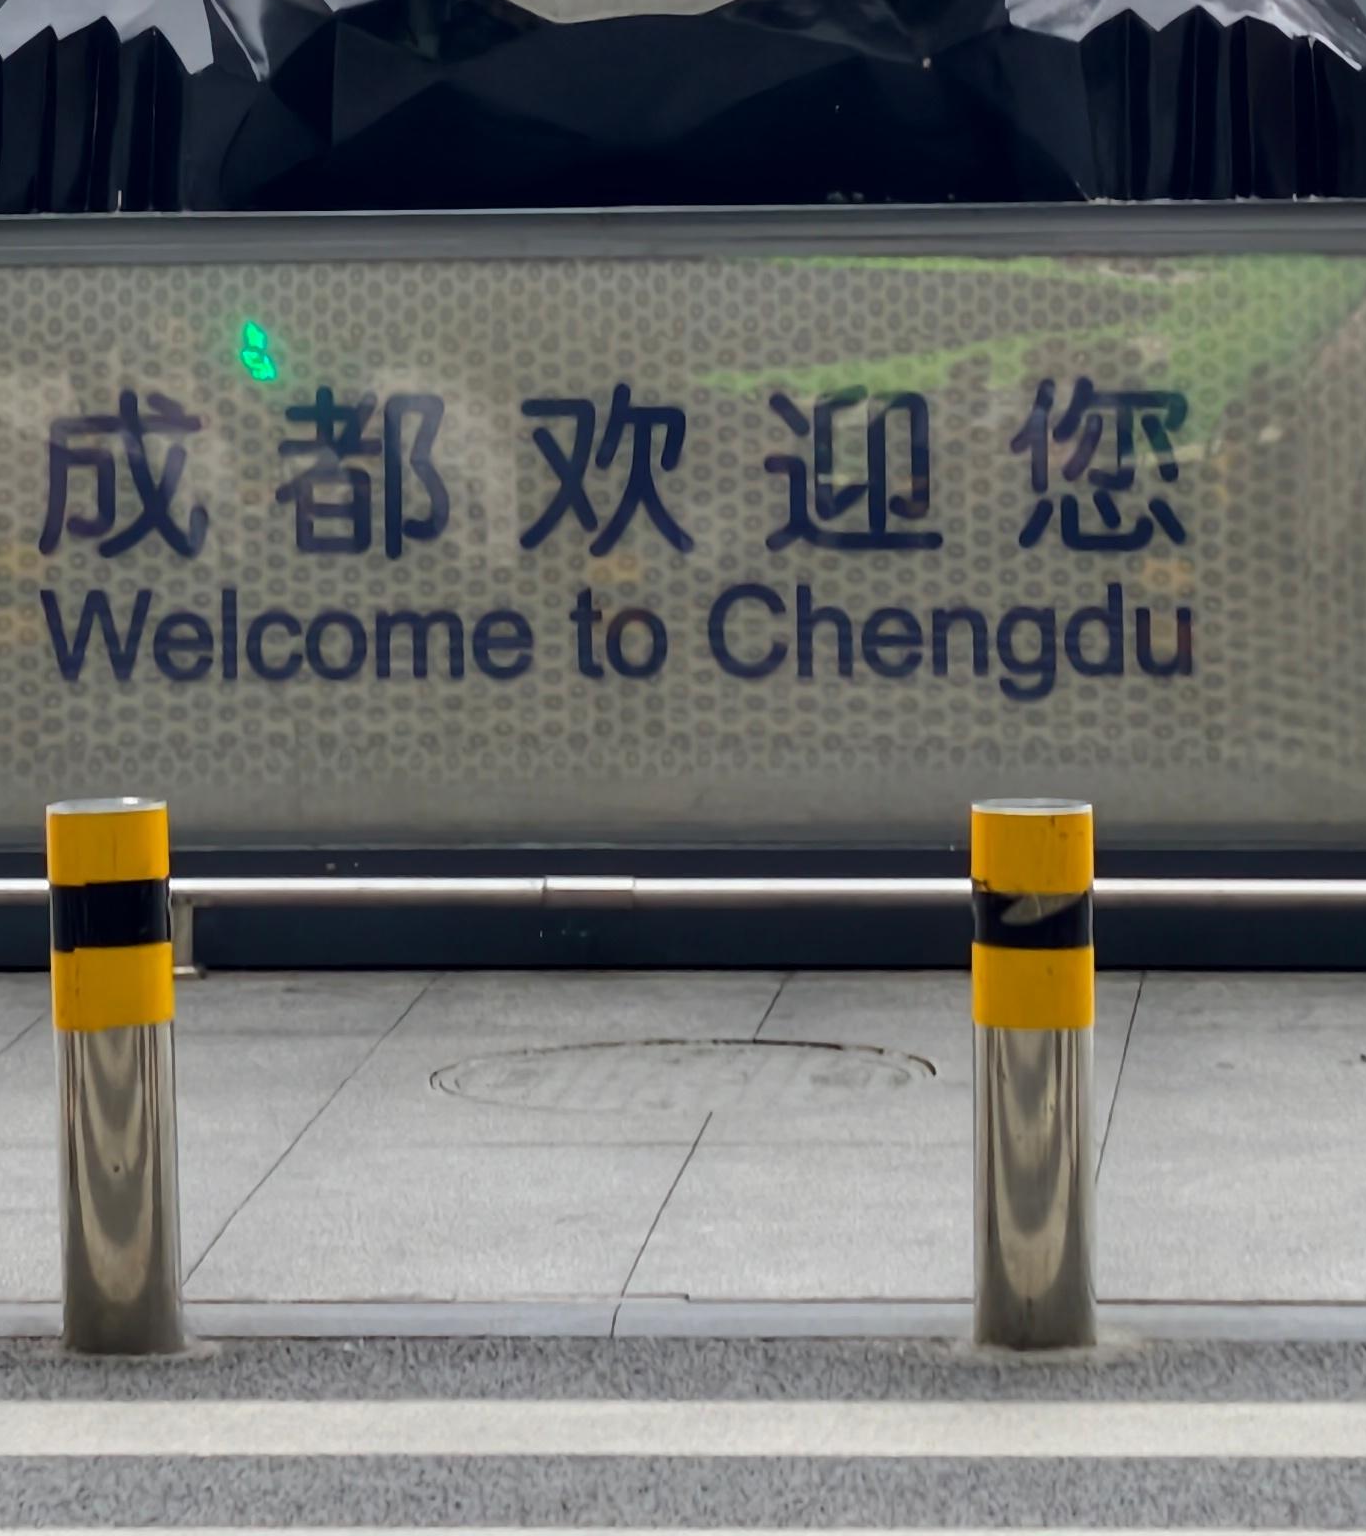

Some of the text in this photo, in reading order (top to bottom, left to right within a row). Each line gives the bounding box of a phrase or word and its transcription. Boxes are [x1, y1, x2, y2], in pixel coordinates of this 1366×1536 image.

[38, 377, 1188, 559] 成都欢迎您
[40, 582, 1194, 702] Welcome to Chengdu
